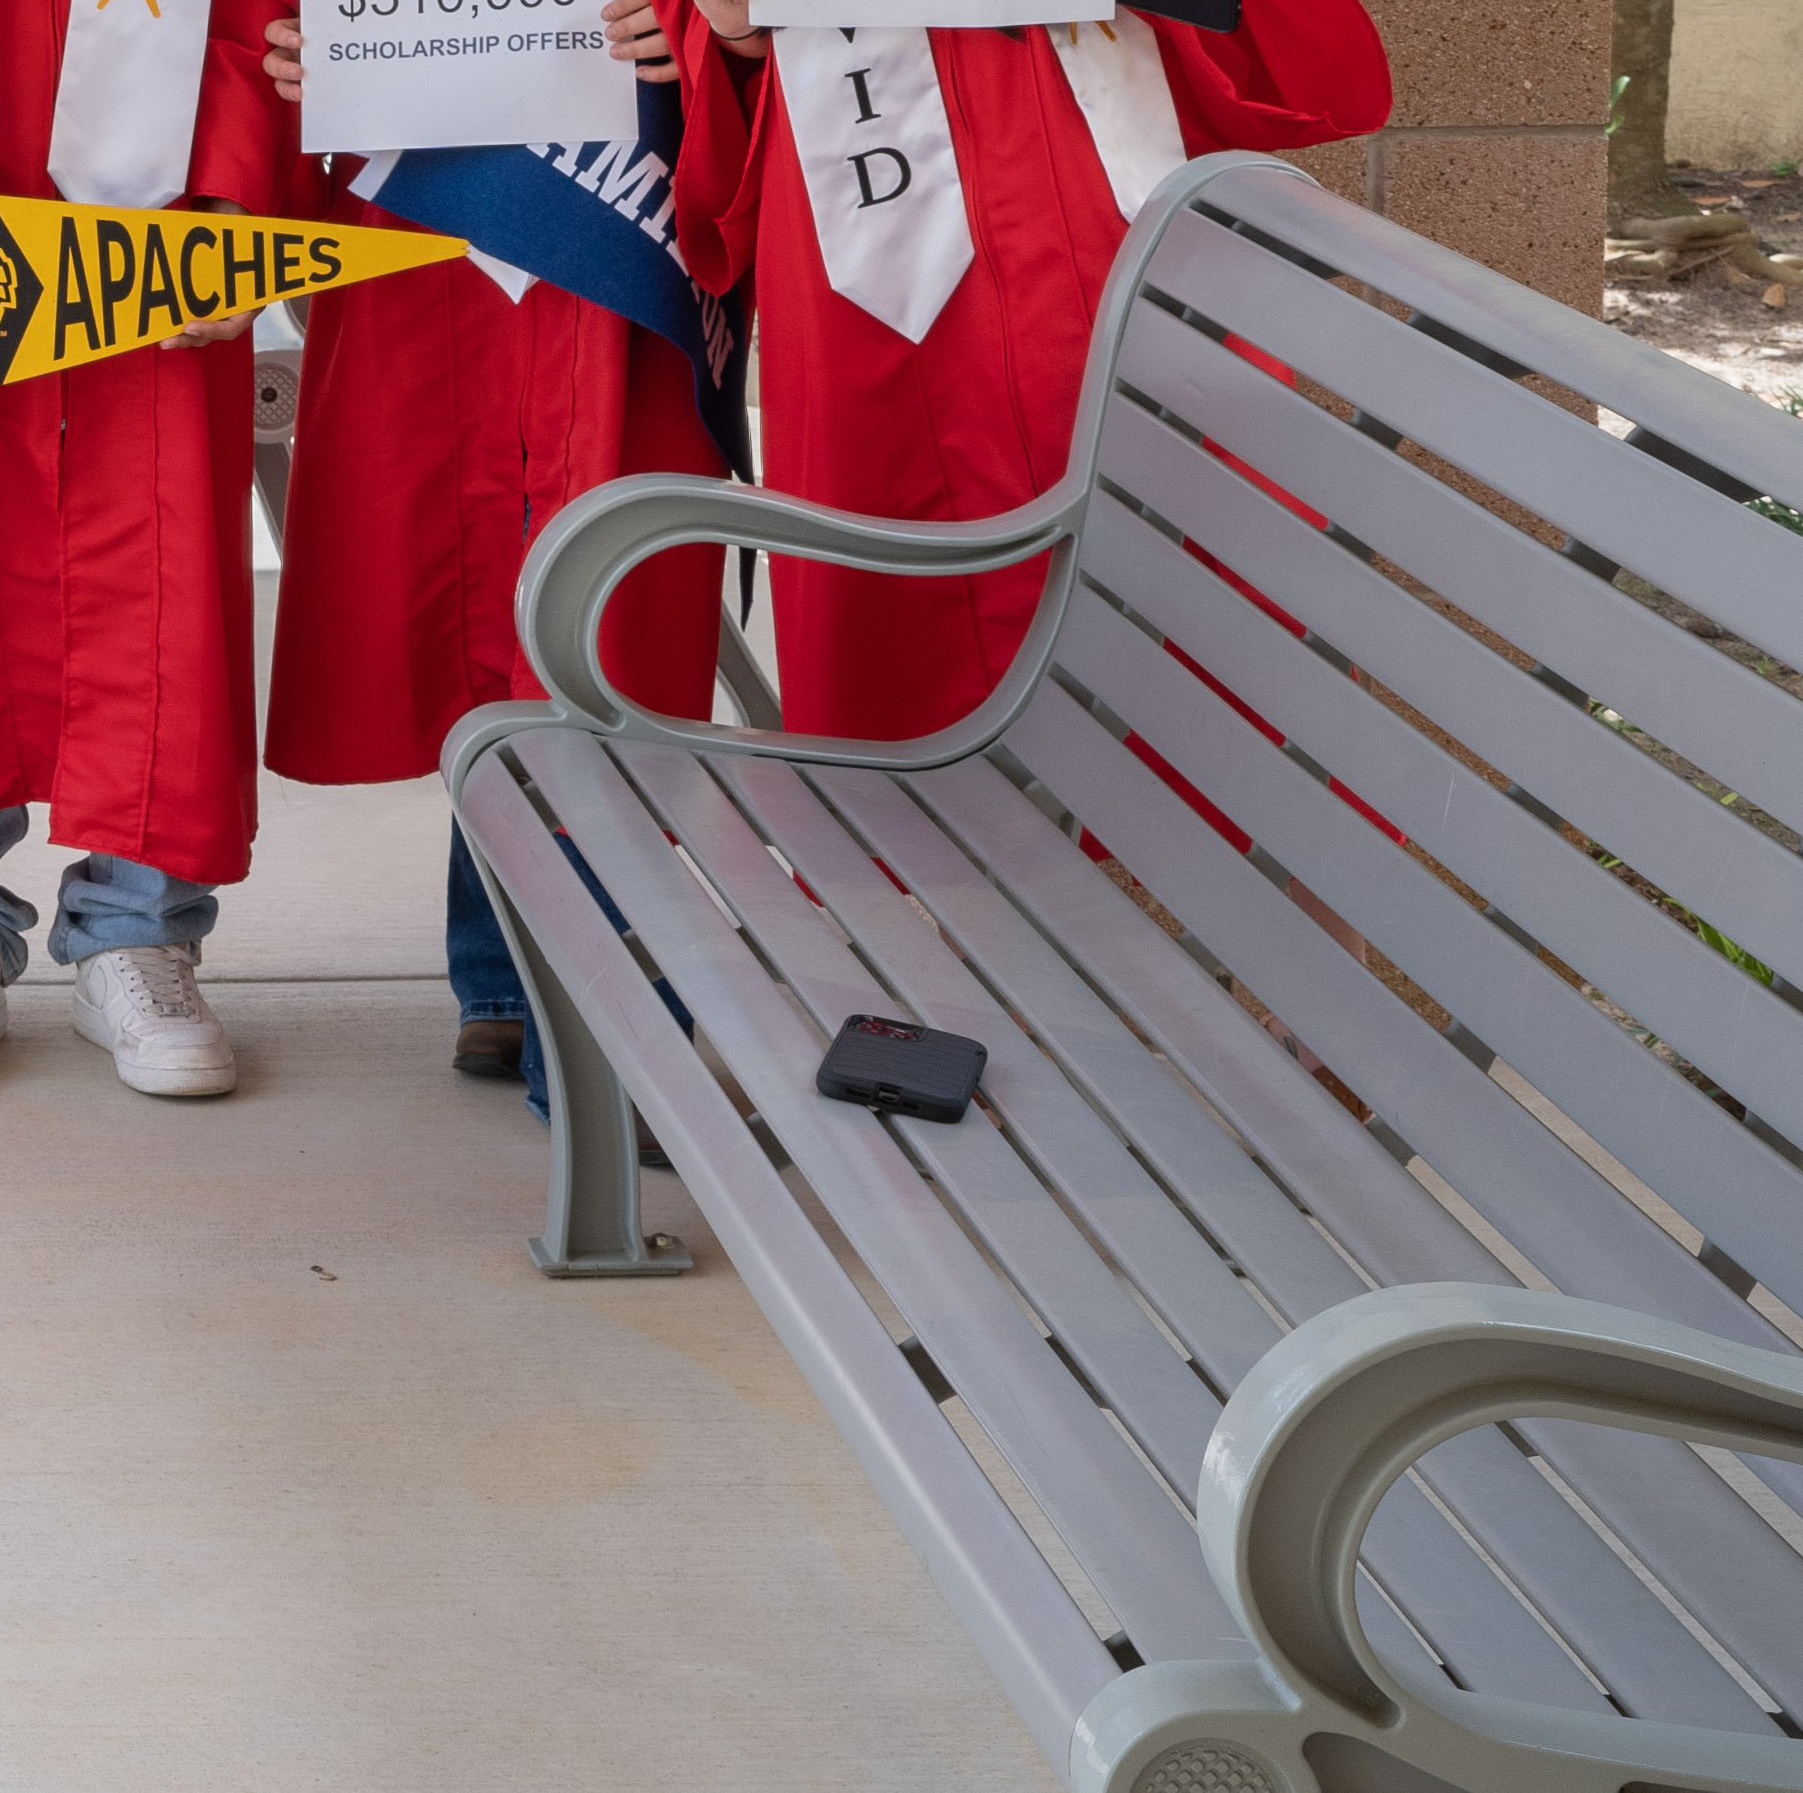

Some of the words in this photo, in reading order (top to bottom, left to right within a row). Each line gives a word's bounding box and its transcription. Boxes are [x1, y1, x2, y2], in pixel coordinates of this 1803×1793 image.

[328, 35, 500, 62] SCHOLARSHIP
[507, 30, 605, 53] OFFERS
[54, 216, 342, 361] APACHES
